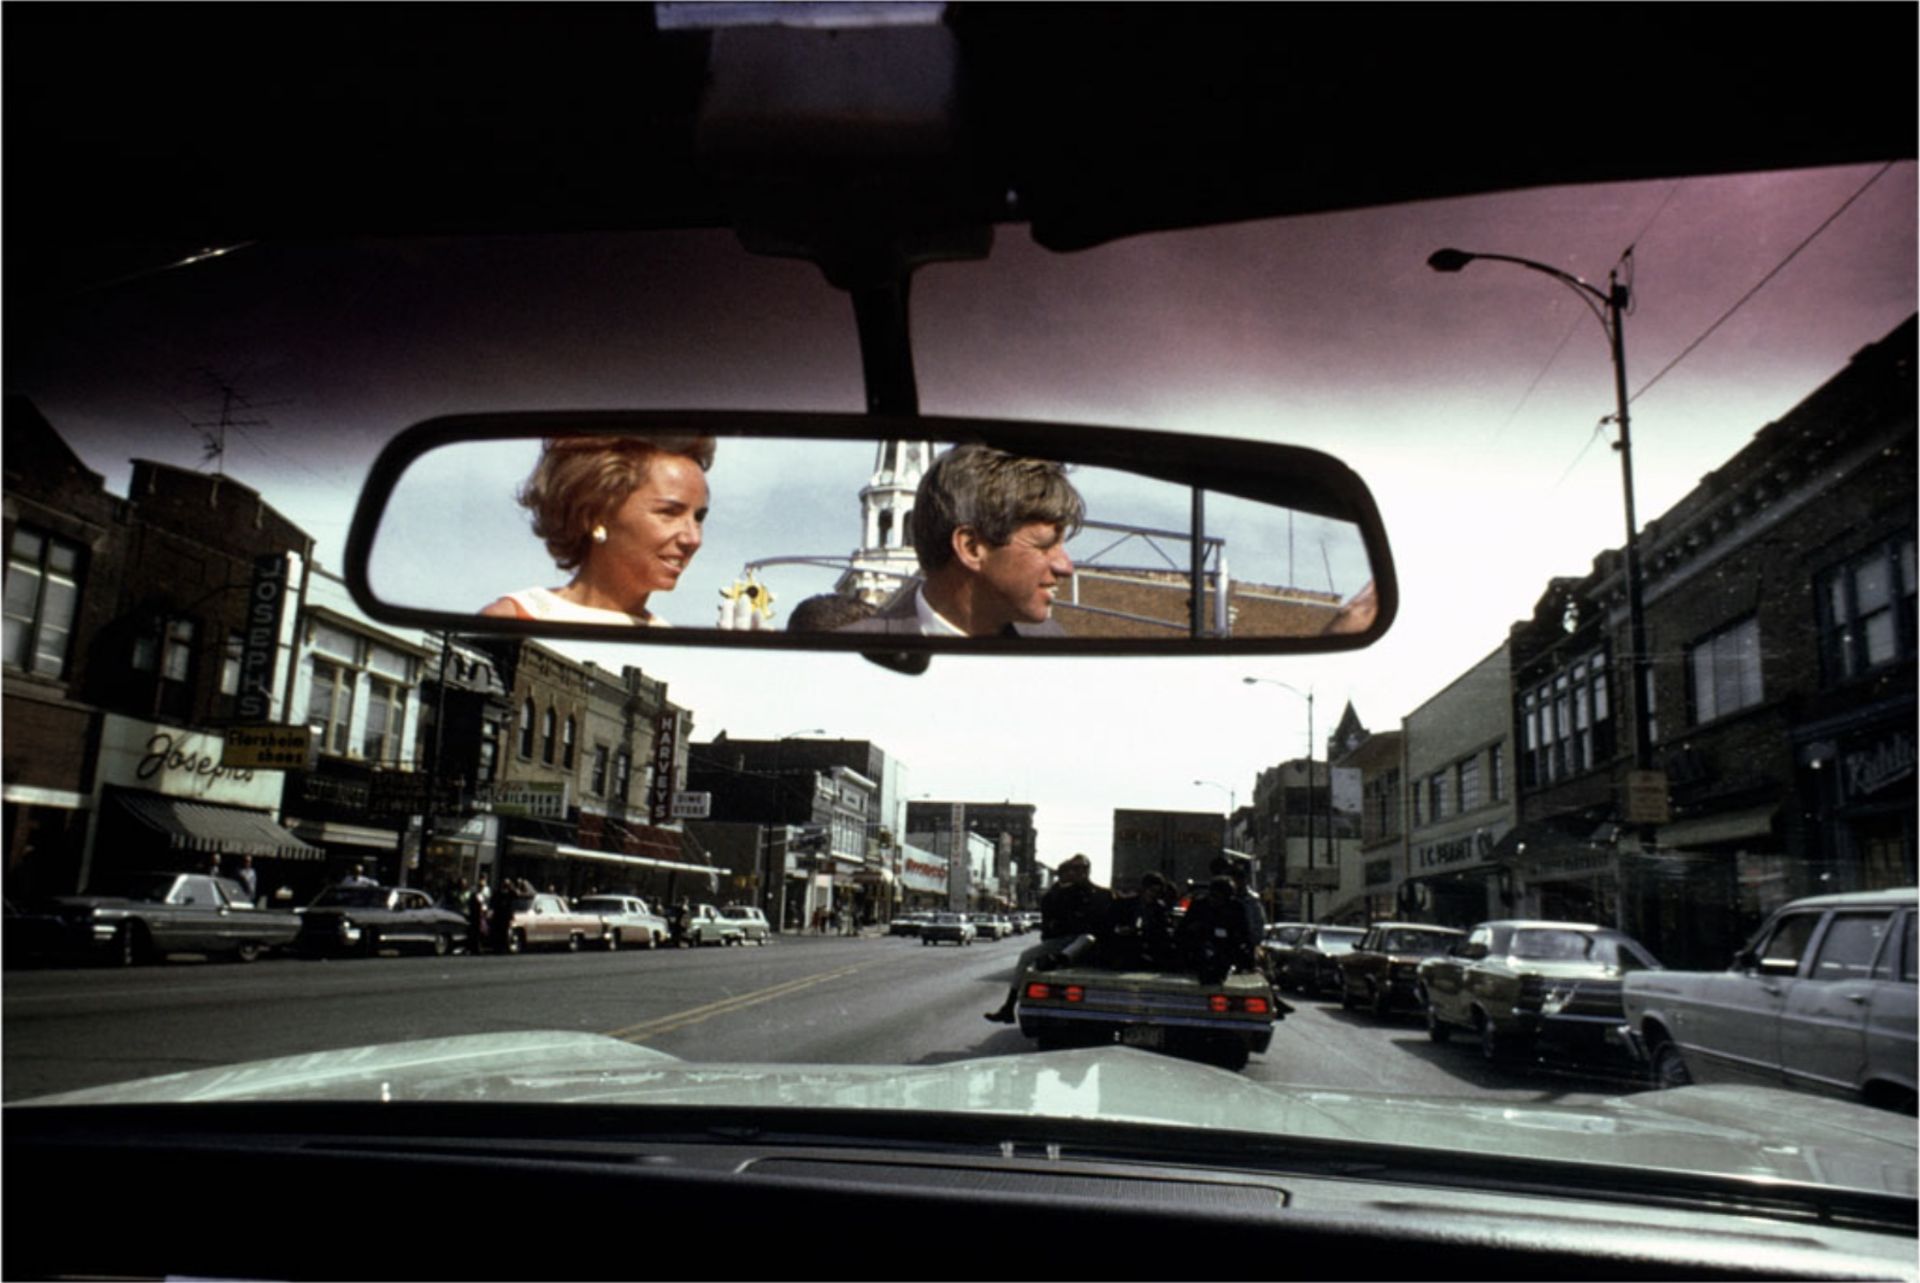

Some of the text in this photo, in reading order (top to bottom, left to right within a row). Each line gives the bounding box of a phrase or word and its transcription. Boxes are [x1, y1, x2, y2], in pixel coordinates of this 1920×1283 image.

[240, 559, 281, 715] JOSEPHS
[230, 730, 304, 746] Florsheim
[258, 749, 302, 762] shoes
[655, 717, 673, 818] HARVEYS
